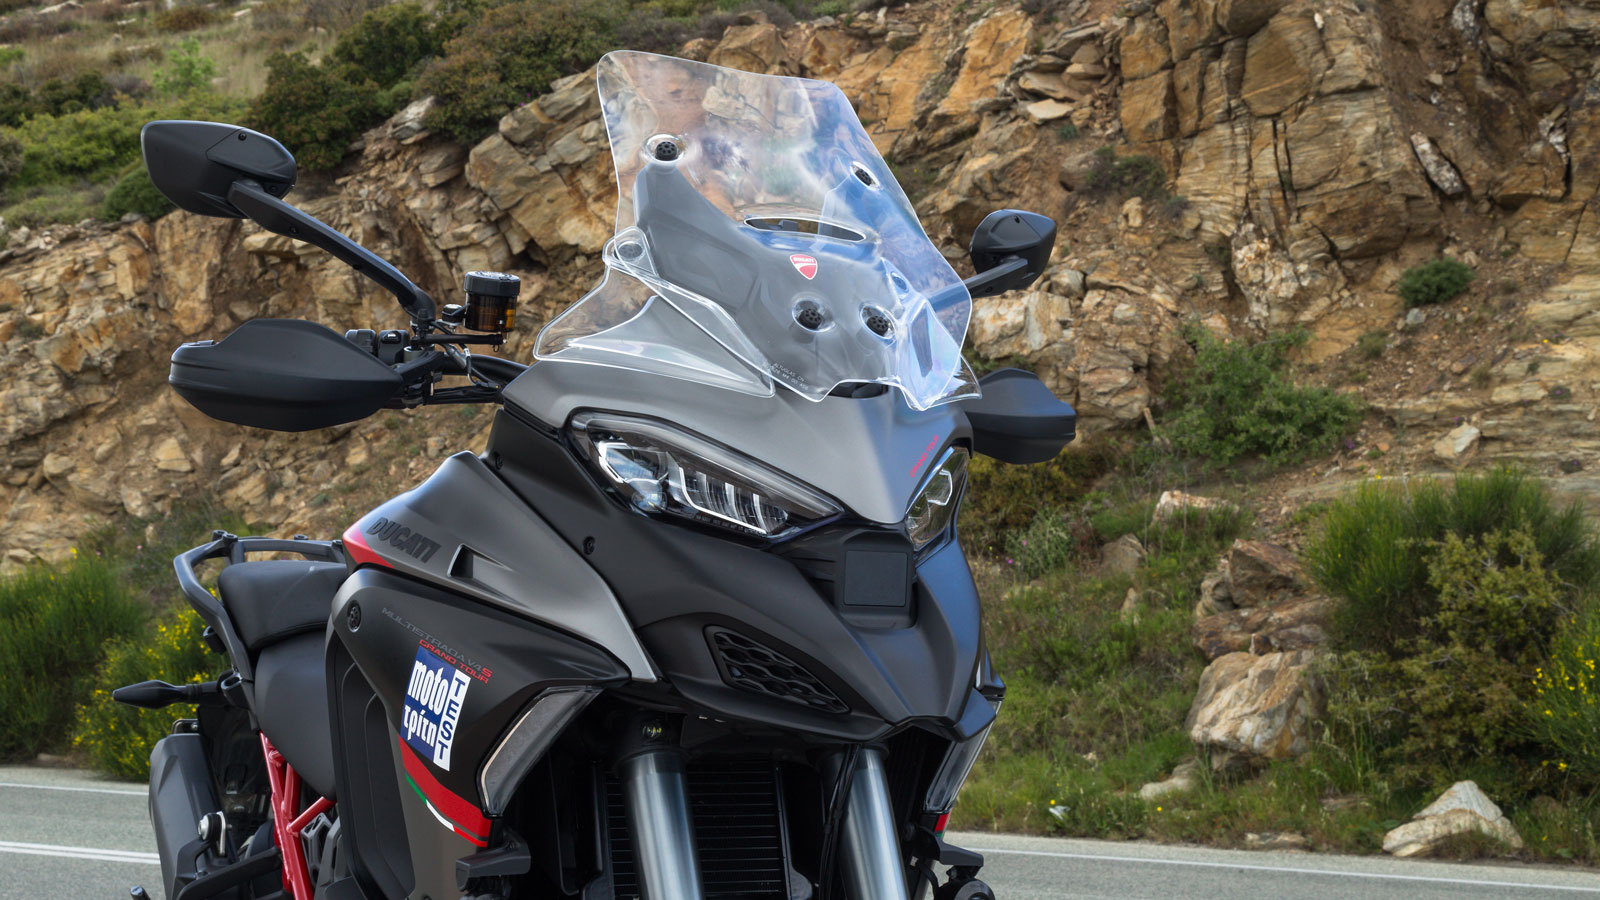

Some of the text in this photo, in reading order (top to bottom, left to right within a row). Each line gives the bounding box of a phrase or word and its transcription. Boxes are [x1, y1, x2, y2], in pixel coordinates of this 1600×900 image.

[909, 434, 940, 479] GRAND TOUR
[366, 517, 442, 564] DUCATI
[382, 607, 465, 663] MULTISTRADA
[419, 639, 489, 685] GRAND TOUR
[407, 660, 449, 716] moto
[438, 677, 466, 761] TEST
